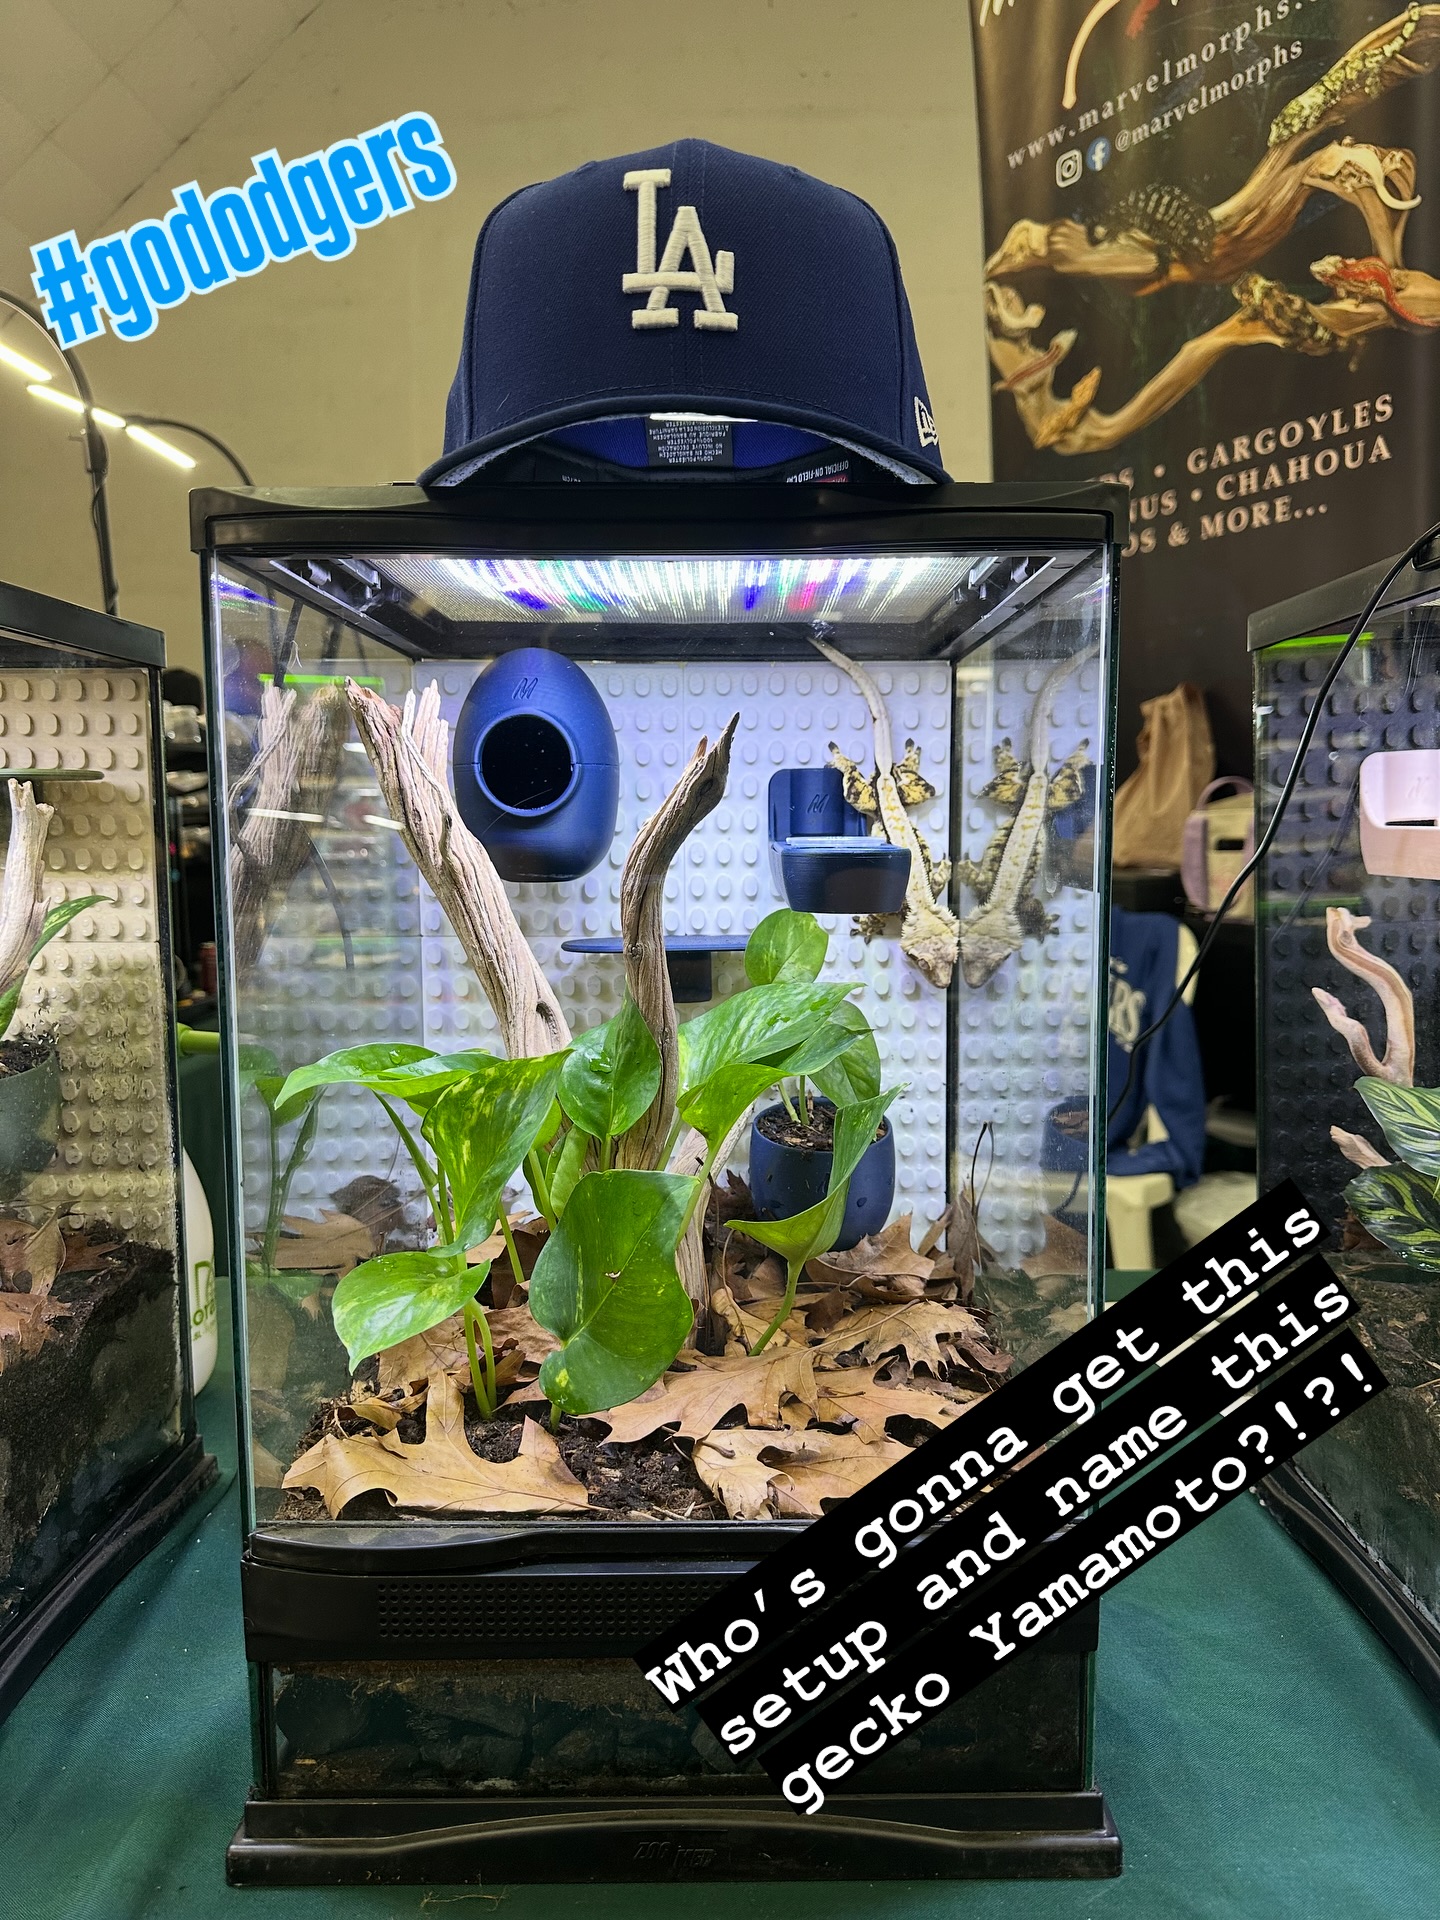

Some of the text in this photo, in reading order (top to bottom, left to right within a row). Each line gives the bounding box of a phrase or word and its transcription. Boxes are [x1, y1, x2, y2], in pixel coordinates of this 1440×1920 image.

[1114, 40, 1303, 152] @marvelmorphs
[622, 168, 738, 331] LA
[1186, 394, 1394, 475] GARGOYLES
[1216, 434, 1393, 501] CHAHOUA
[1168, 521, 1190, 548] &
[1200, 495, 1329, 542] MORE...
